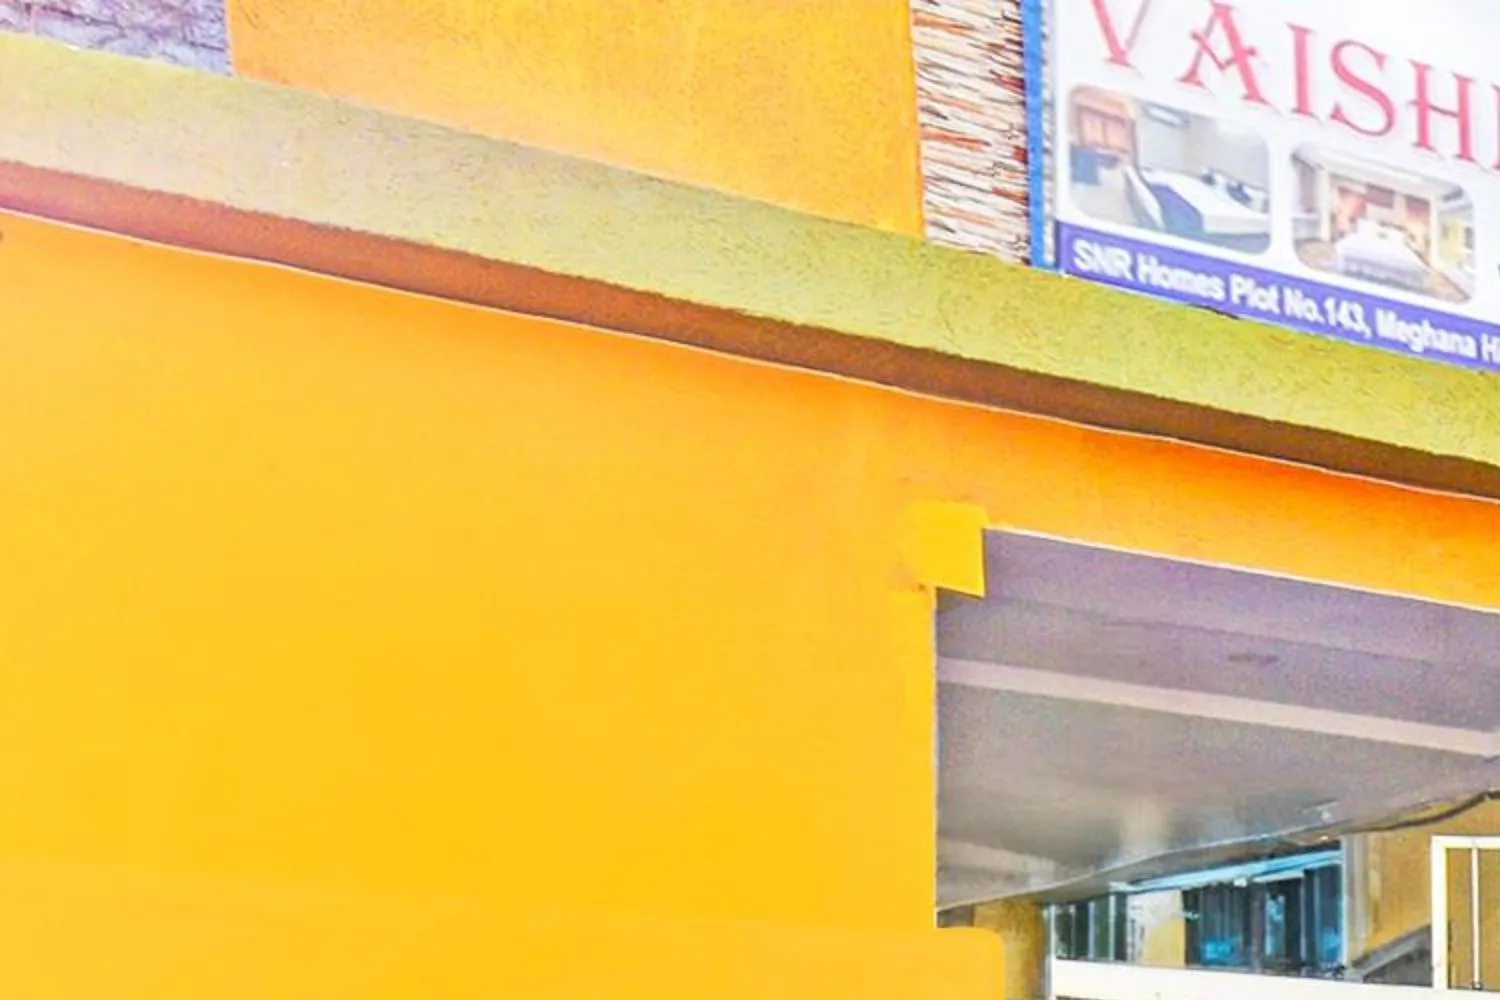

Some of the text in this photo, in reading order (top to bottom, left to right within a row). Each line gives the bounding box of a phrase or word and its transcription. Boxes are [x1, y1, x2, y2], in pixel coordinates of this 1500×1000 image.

[1072, 237, 1135, 282] SNR
[1136, 252, 1227, 302] Homes
[1229, 272, 1281, 315] Plot
[1375, 307, 1478, 354] Meghana
